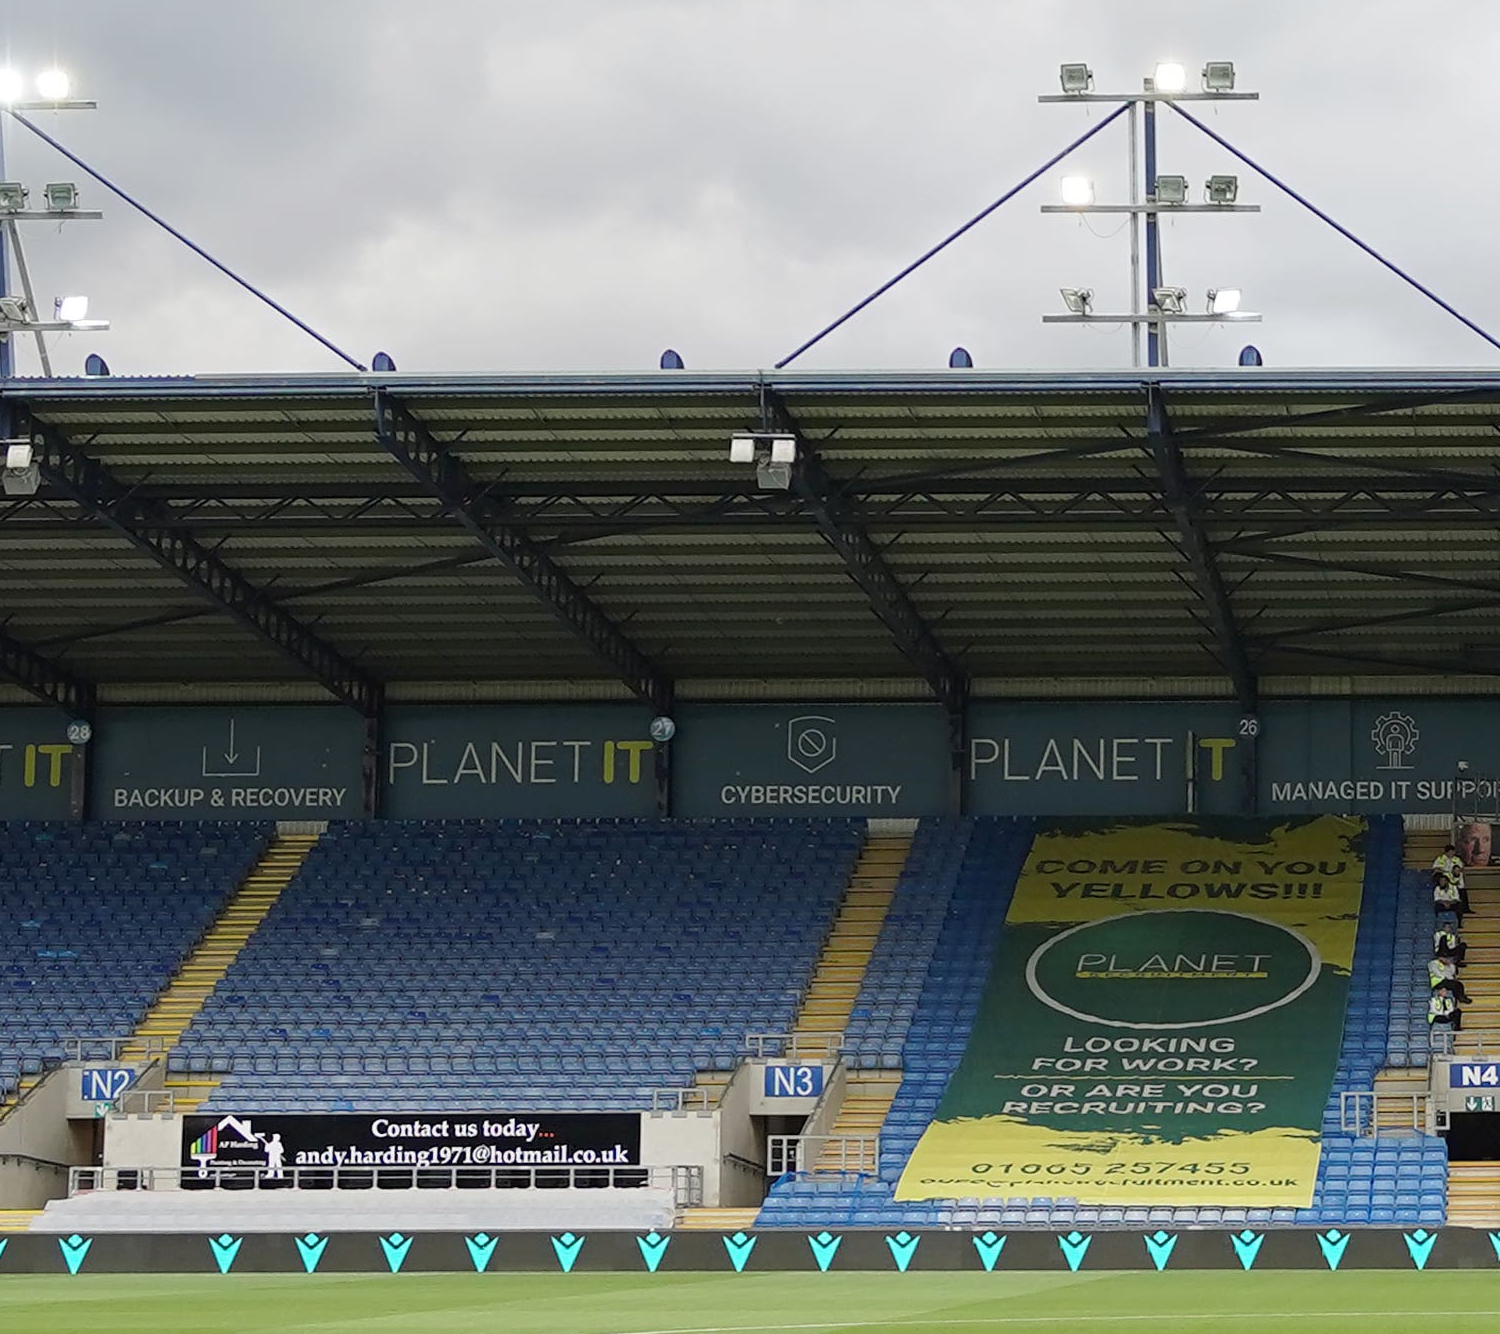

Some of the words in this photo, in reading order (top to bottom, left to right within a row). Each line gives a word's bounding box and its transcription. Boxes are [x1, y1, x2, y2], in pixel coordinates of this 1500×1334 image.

[69, 725, 90, 740] 28
[653, 720, 672, 736] 27
[1239, 719, 1258, 736] 26
[24, 744, 73, 787] IT
[389, 741, 592, 784] PLANET
[603, 740, 654, 784] IT
[970, 738, 1173, 781] PLANET
[114, 788, 205, 807] BACKUP
[210, 788, 225, 807] &
[231, 787, 347, 807] RECOVERY
[721, 785, 901, 805] CYBERSECURITY
[1272, 780, 1384, 801] MANAGED
[1391, 781, 1411, 800] IT
[1035, 859, 1168, 876] COME
[1180, 859, 1243, 876] ON
[1257, 860, 1347, 876] YOU
[1050, 881, 1323, 900] YELLOWS!!!
[1076, 954, 1273, 973] PLANET
[1063, 1036, 1235, 1053] LOOKING
[1031, 1057, 1109, 1072] FOR
[1121, 1057, 1259, 1072] WORK?
[91, 1069, 130, 1099] N2
[774, 1067, 813, 1096] N3
[1462, 1065, 1499, 1086] N4
[1020, 1083, 1076, 1098] OR
[1084, 1083, 1167, 1098] ARE
[1177, 1083, 1258, 1098] YOU
[1001, 1101, 1266, 1115] RECRUITING?
[371, 1118, 450, 1138] Contact
[454, 1123, 478, 1138] us
[482, 1118, 555, 1142] today...
[295, 1144, 629, 1167] andy.harding1971@hotmail.co.uk
[1104, 1161, 1251, 1175] 257455
